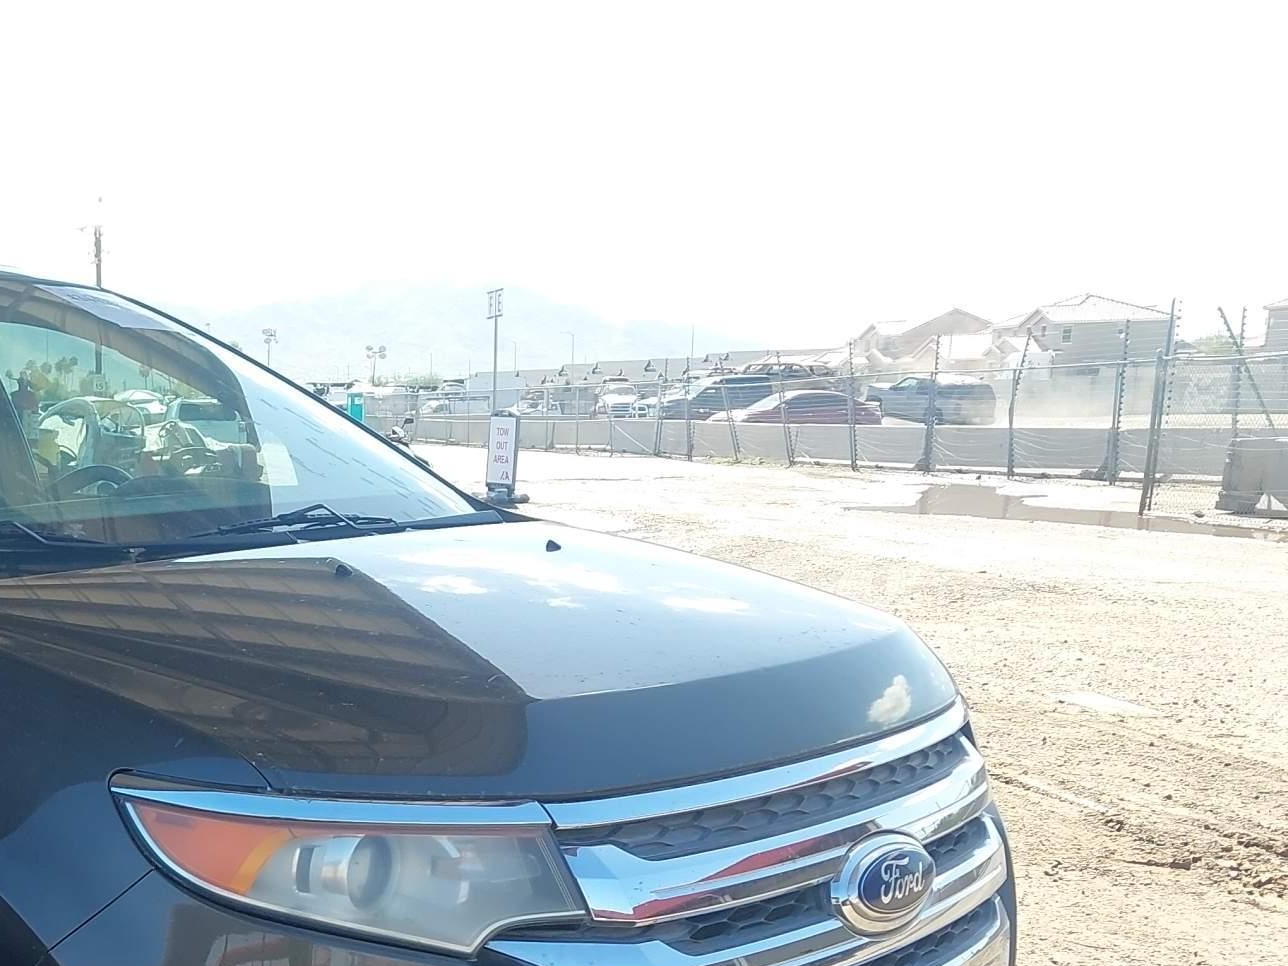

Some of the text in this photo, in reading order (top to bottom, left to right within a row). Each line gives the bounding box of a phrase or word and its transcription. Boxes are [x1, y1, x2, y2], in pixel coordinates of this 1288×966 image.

[496, 427, 510, 437] TOW
[495, 441, 509, 451] OUT
[493, 455, 509, 465] AREA
[880, 856, 925, 904] Ford
